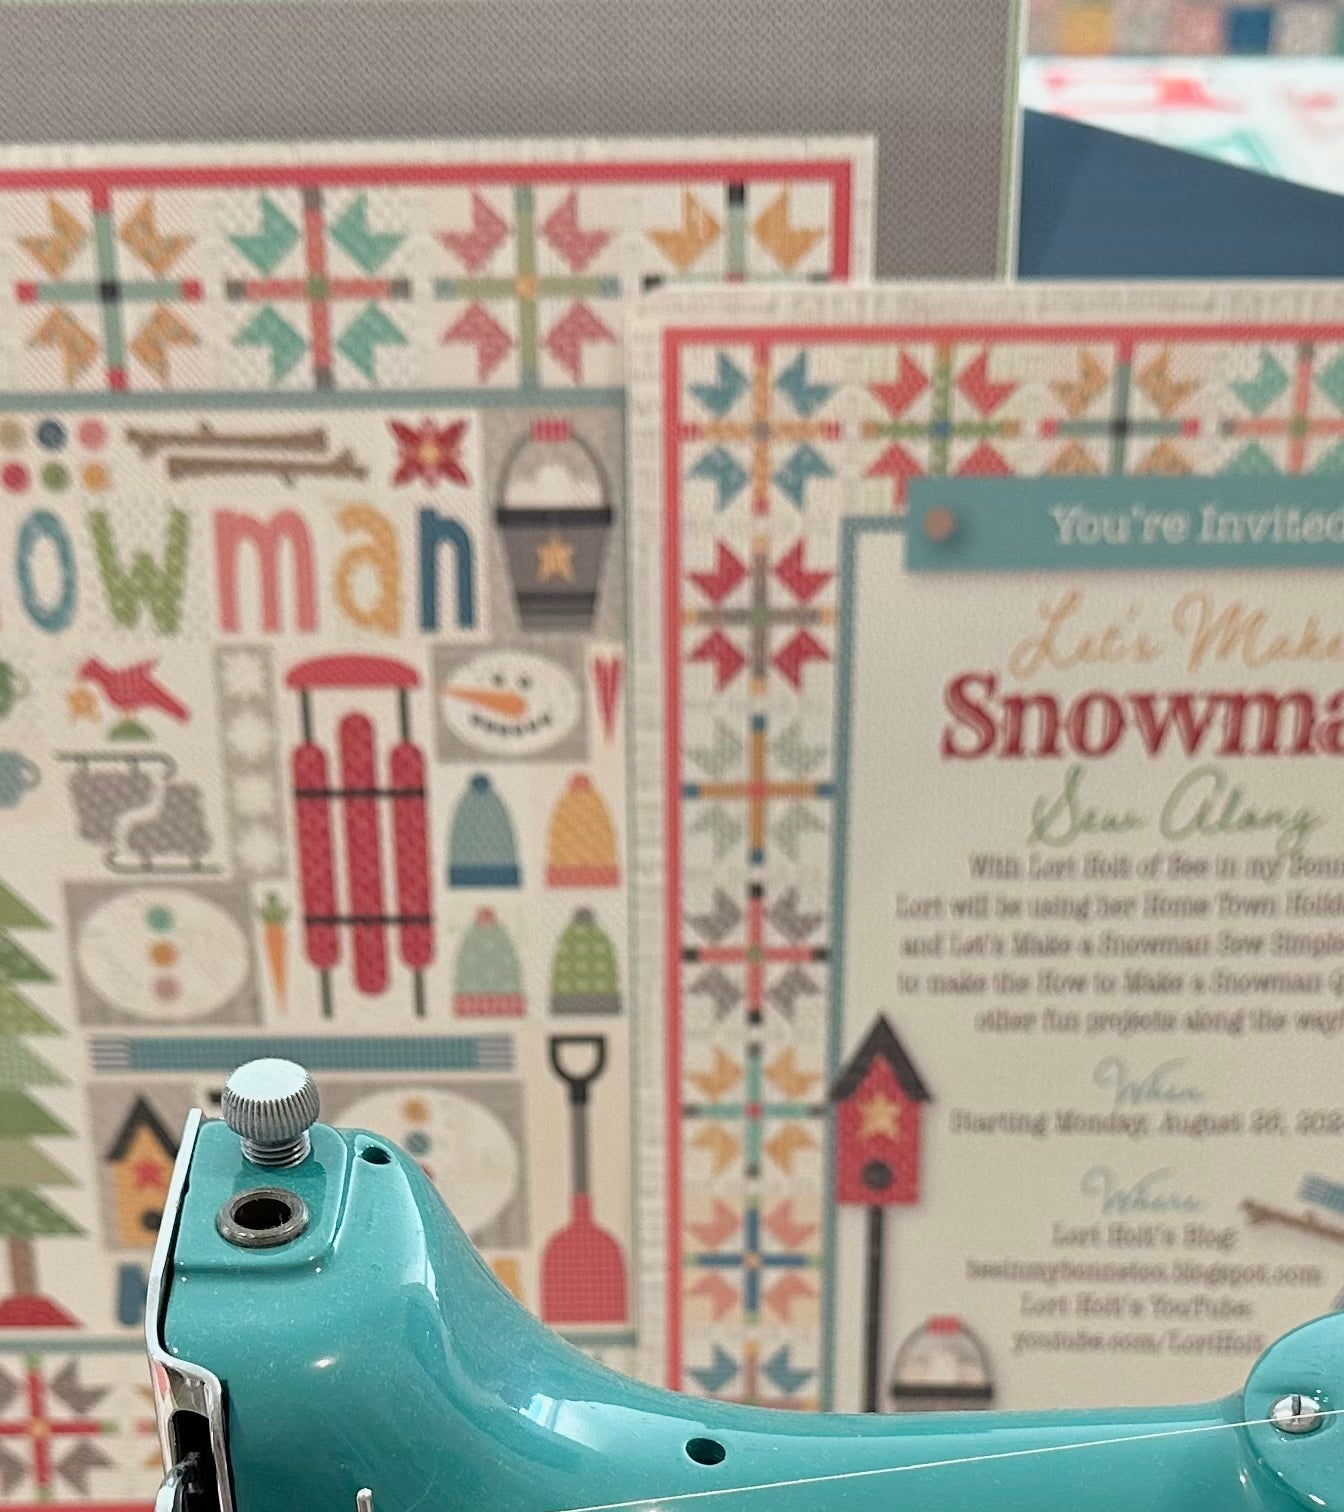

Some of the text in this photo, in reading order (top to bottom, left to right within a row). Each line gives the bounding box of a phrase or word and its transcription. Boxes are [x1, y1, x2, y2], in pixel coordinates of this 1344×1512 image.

[1051, 503, 1187, 545] You're
[1008, 588, 1156, 678] Let's
[1030, 764, 1324, 852] Sew Along
[969, 853, 1020, 880] With
[950, 1110, 1046, 1139] Starting
[1053, 1222, 1102, 1248] Lori
[1182, 1223, 1240, 1251] Blog
[1021, 1291, 1071, 1318] Lori
